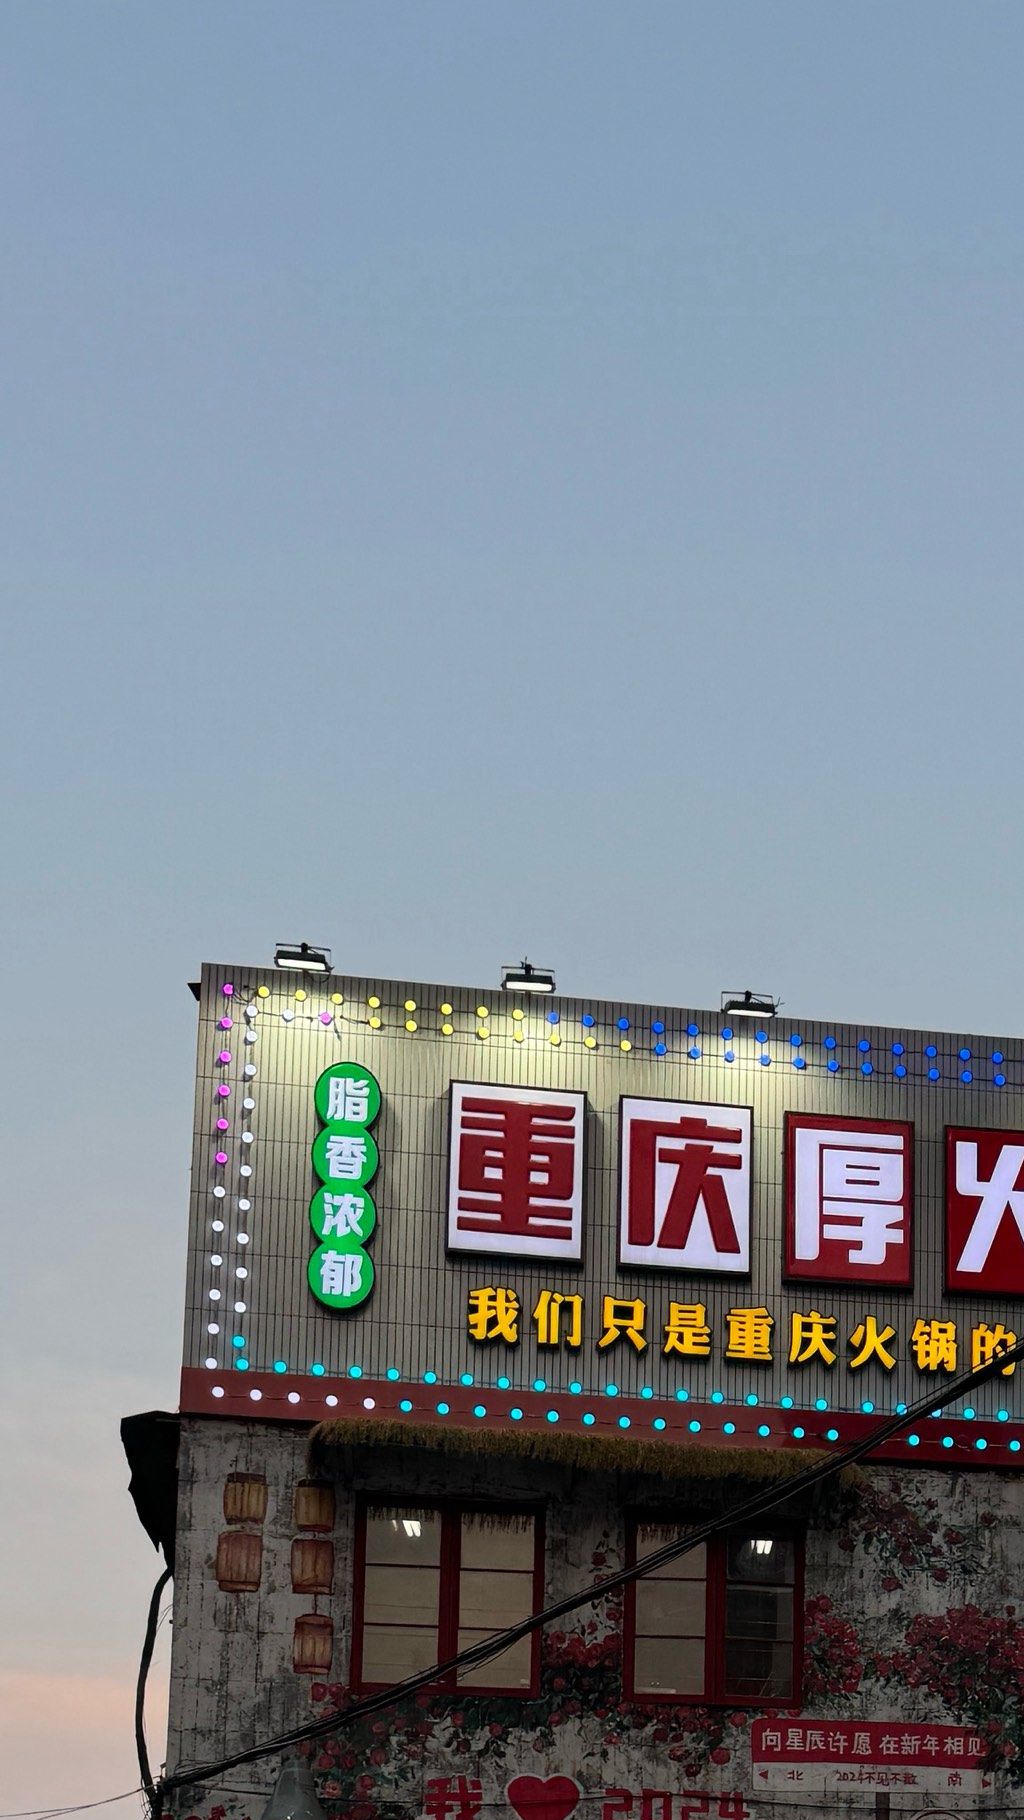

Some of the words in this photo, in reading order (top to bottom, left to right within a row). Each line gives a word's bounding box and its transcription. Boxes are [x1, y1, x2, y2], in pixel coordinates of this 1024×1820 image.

[319, 1075, 370, 1297] 脂香浓郁
[762, 1728, 873, 1756] 向星辰许愿
[879, 1733, 985, 1757] 在新年相见
[787, 1771, 803, 1780] 北
